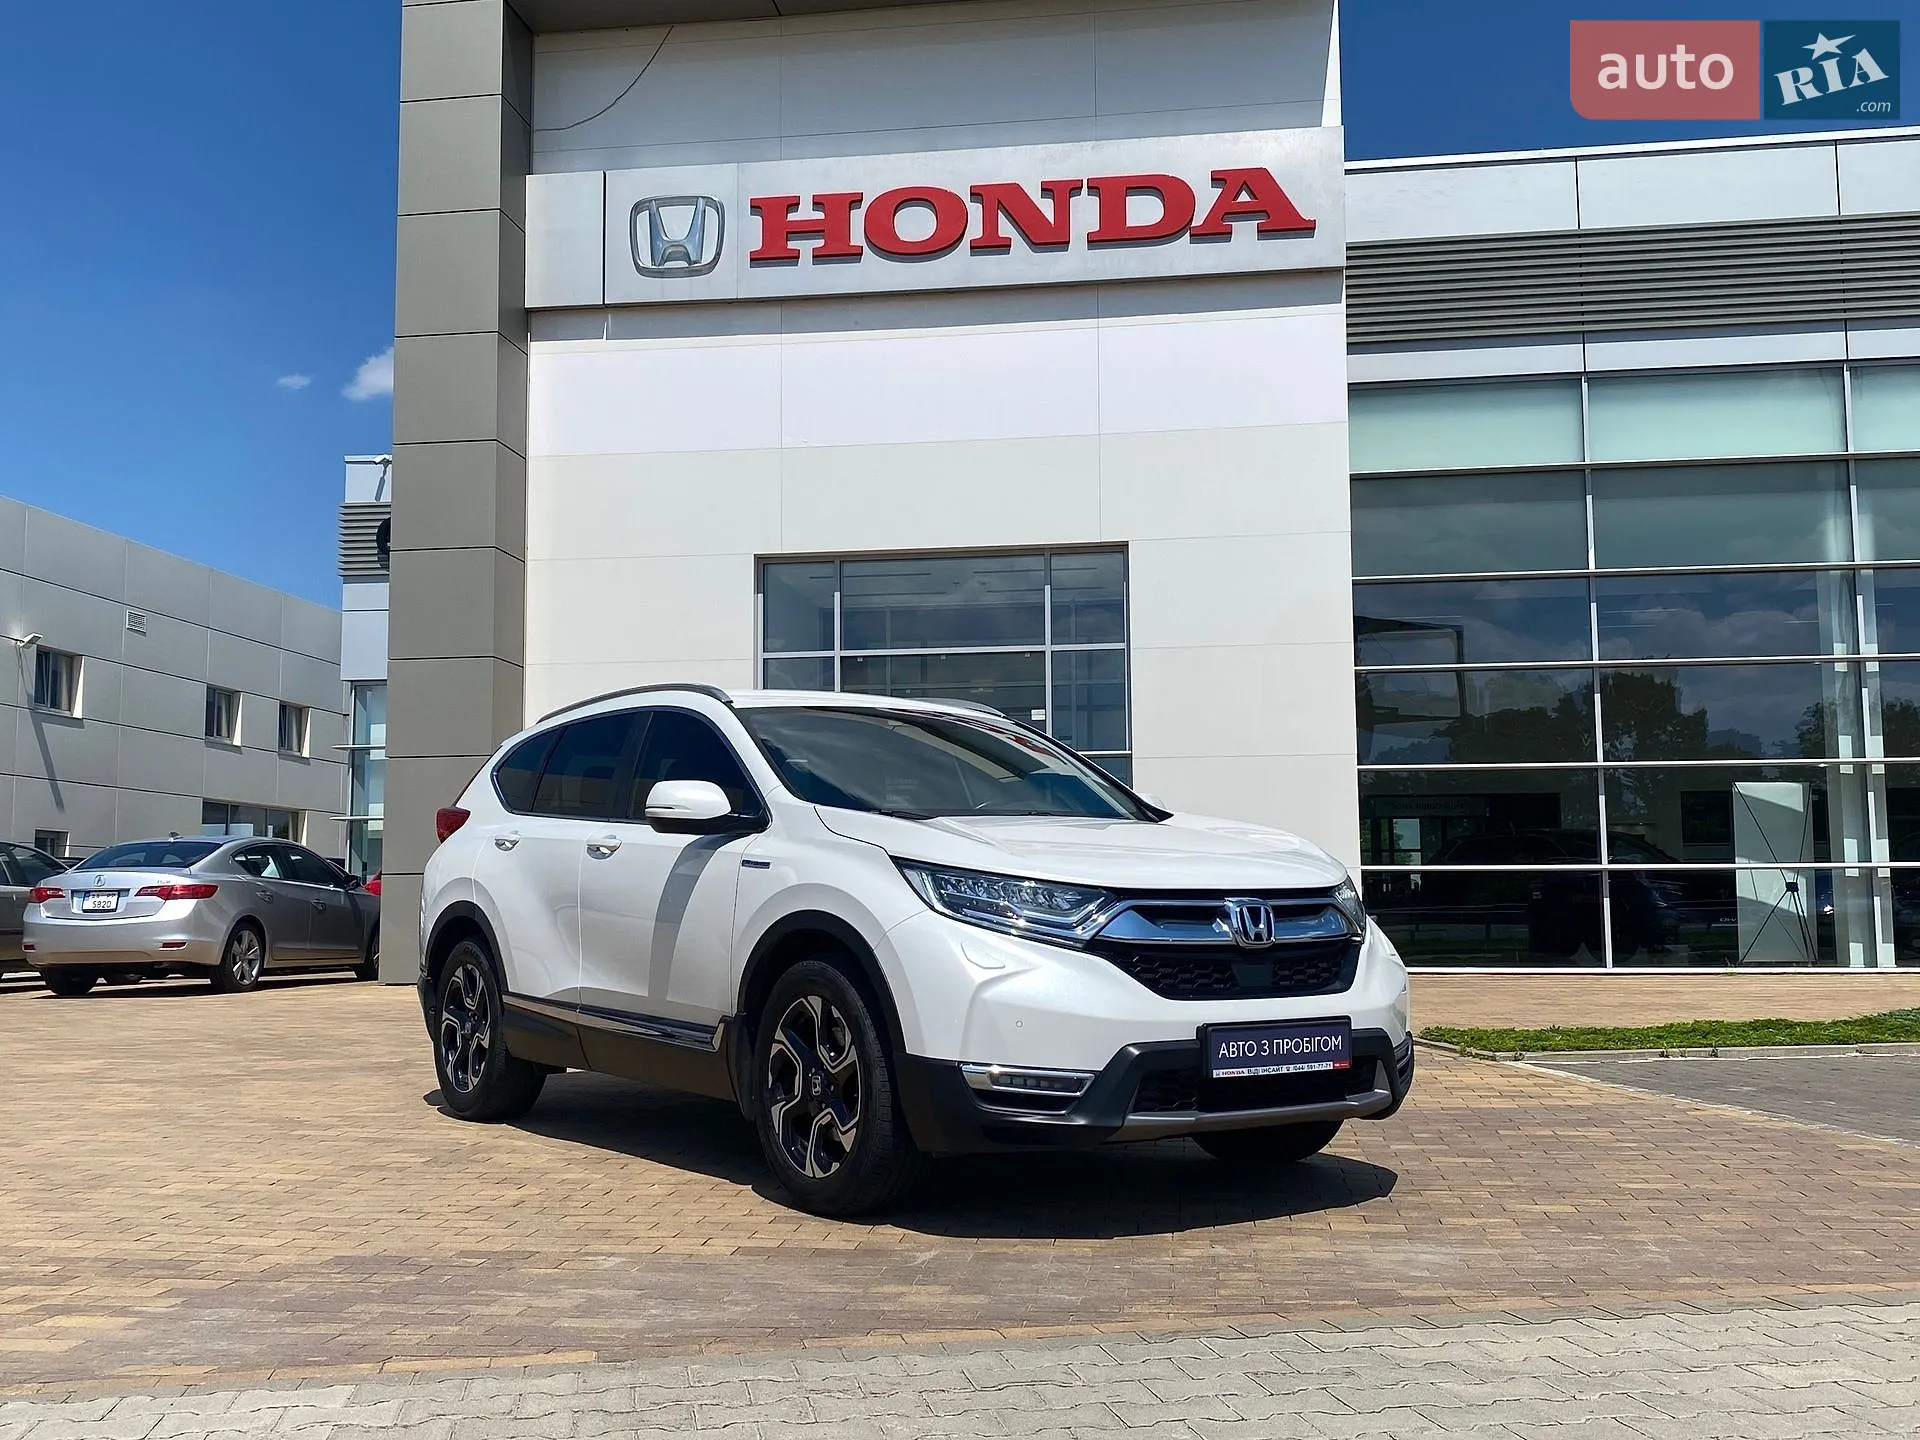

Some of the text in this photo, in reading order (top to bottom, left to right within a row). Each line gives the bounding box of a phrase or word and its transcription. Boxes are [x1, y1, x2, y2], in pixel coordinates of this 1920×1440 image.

[749, 167, 1317, 263] HONDA
[1218, 1041, 1257, 1059] АВТО
[1273, 1035, 1342, 1055] ПРОБІГОМ
